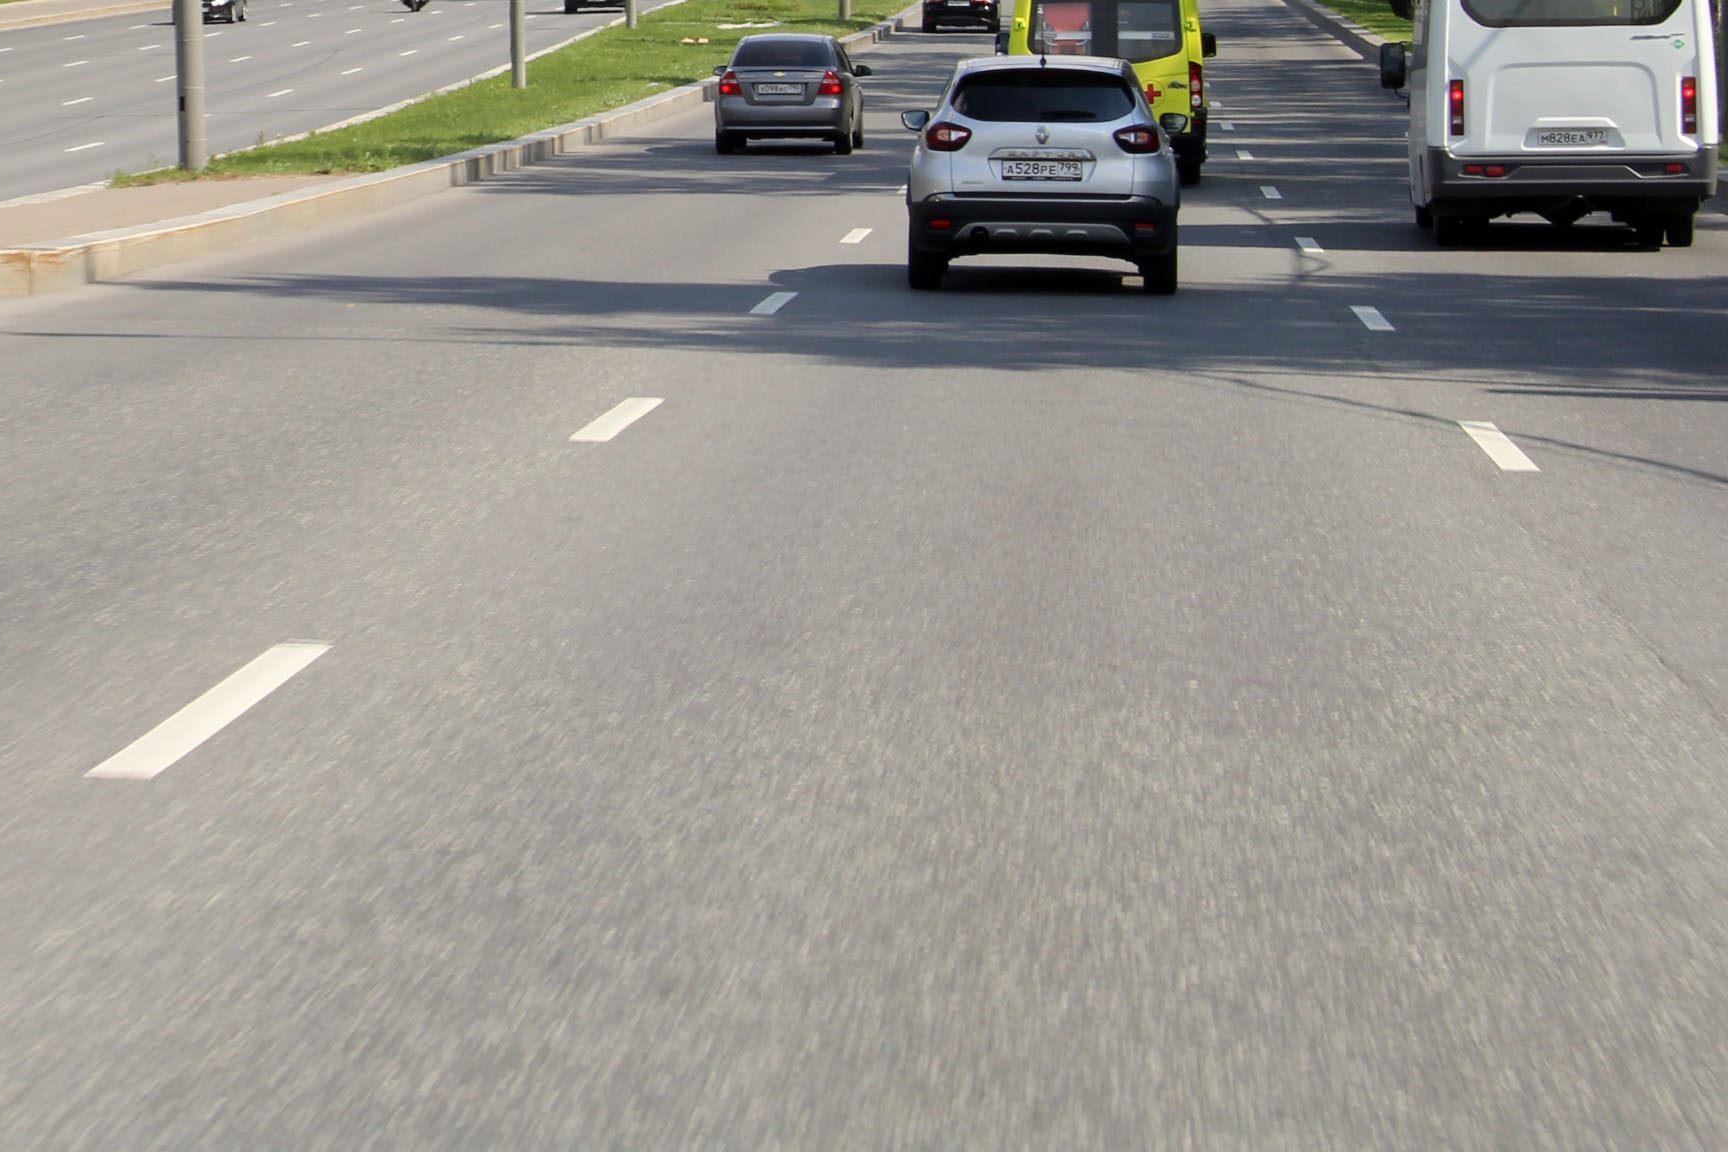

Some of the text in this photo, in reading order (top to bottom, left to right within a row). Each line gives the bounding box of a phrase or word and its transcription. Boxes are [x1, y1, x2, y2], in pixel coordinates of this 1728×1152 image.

[1587, 130, 1605, 140] 977
[1007, 162, 1079, 175] А528РЕ 799
